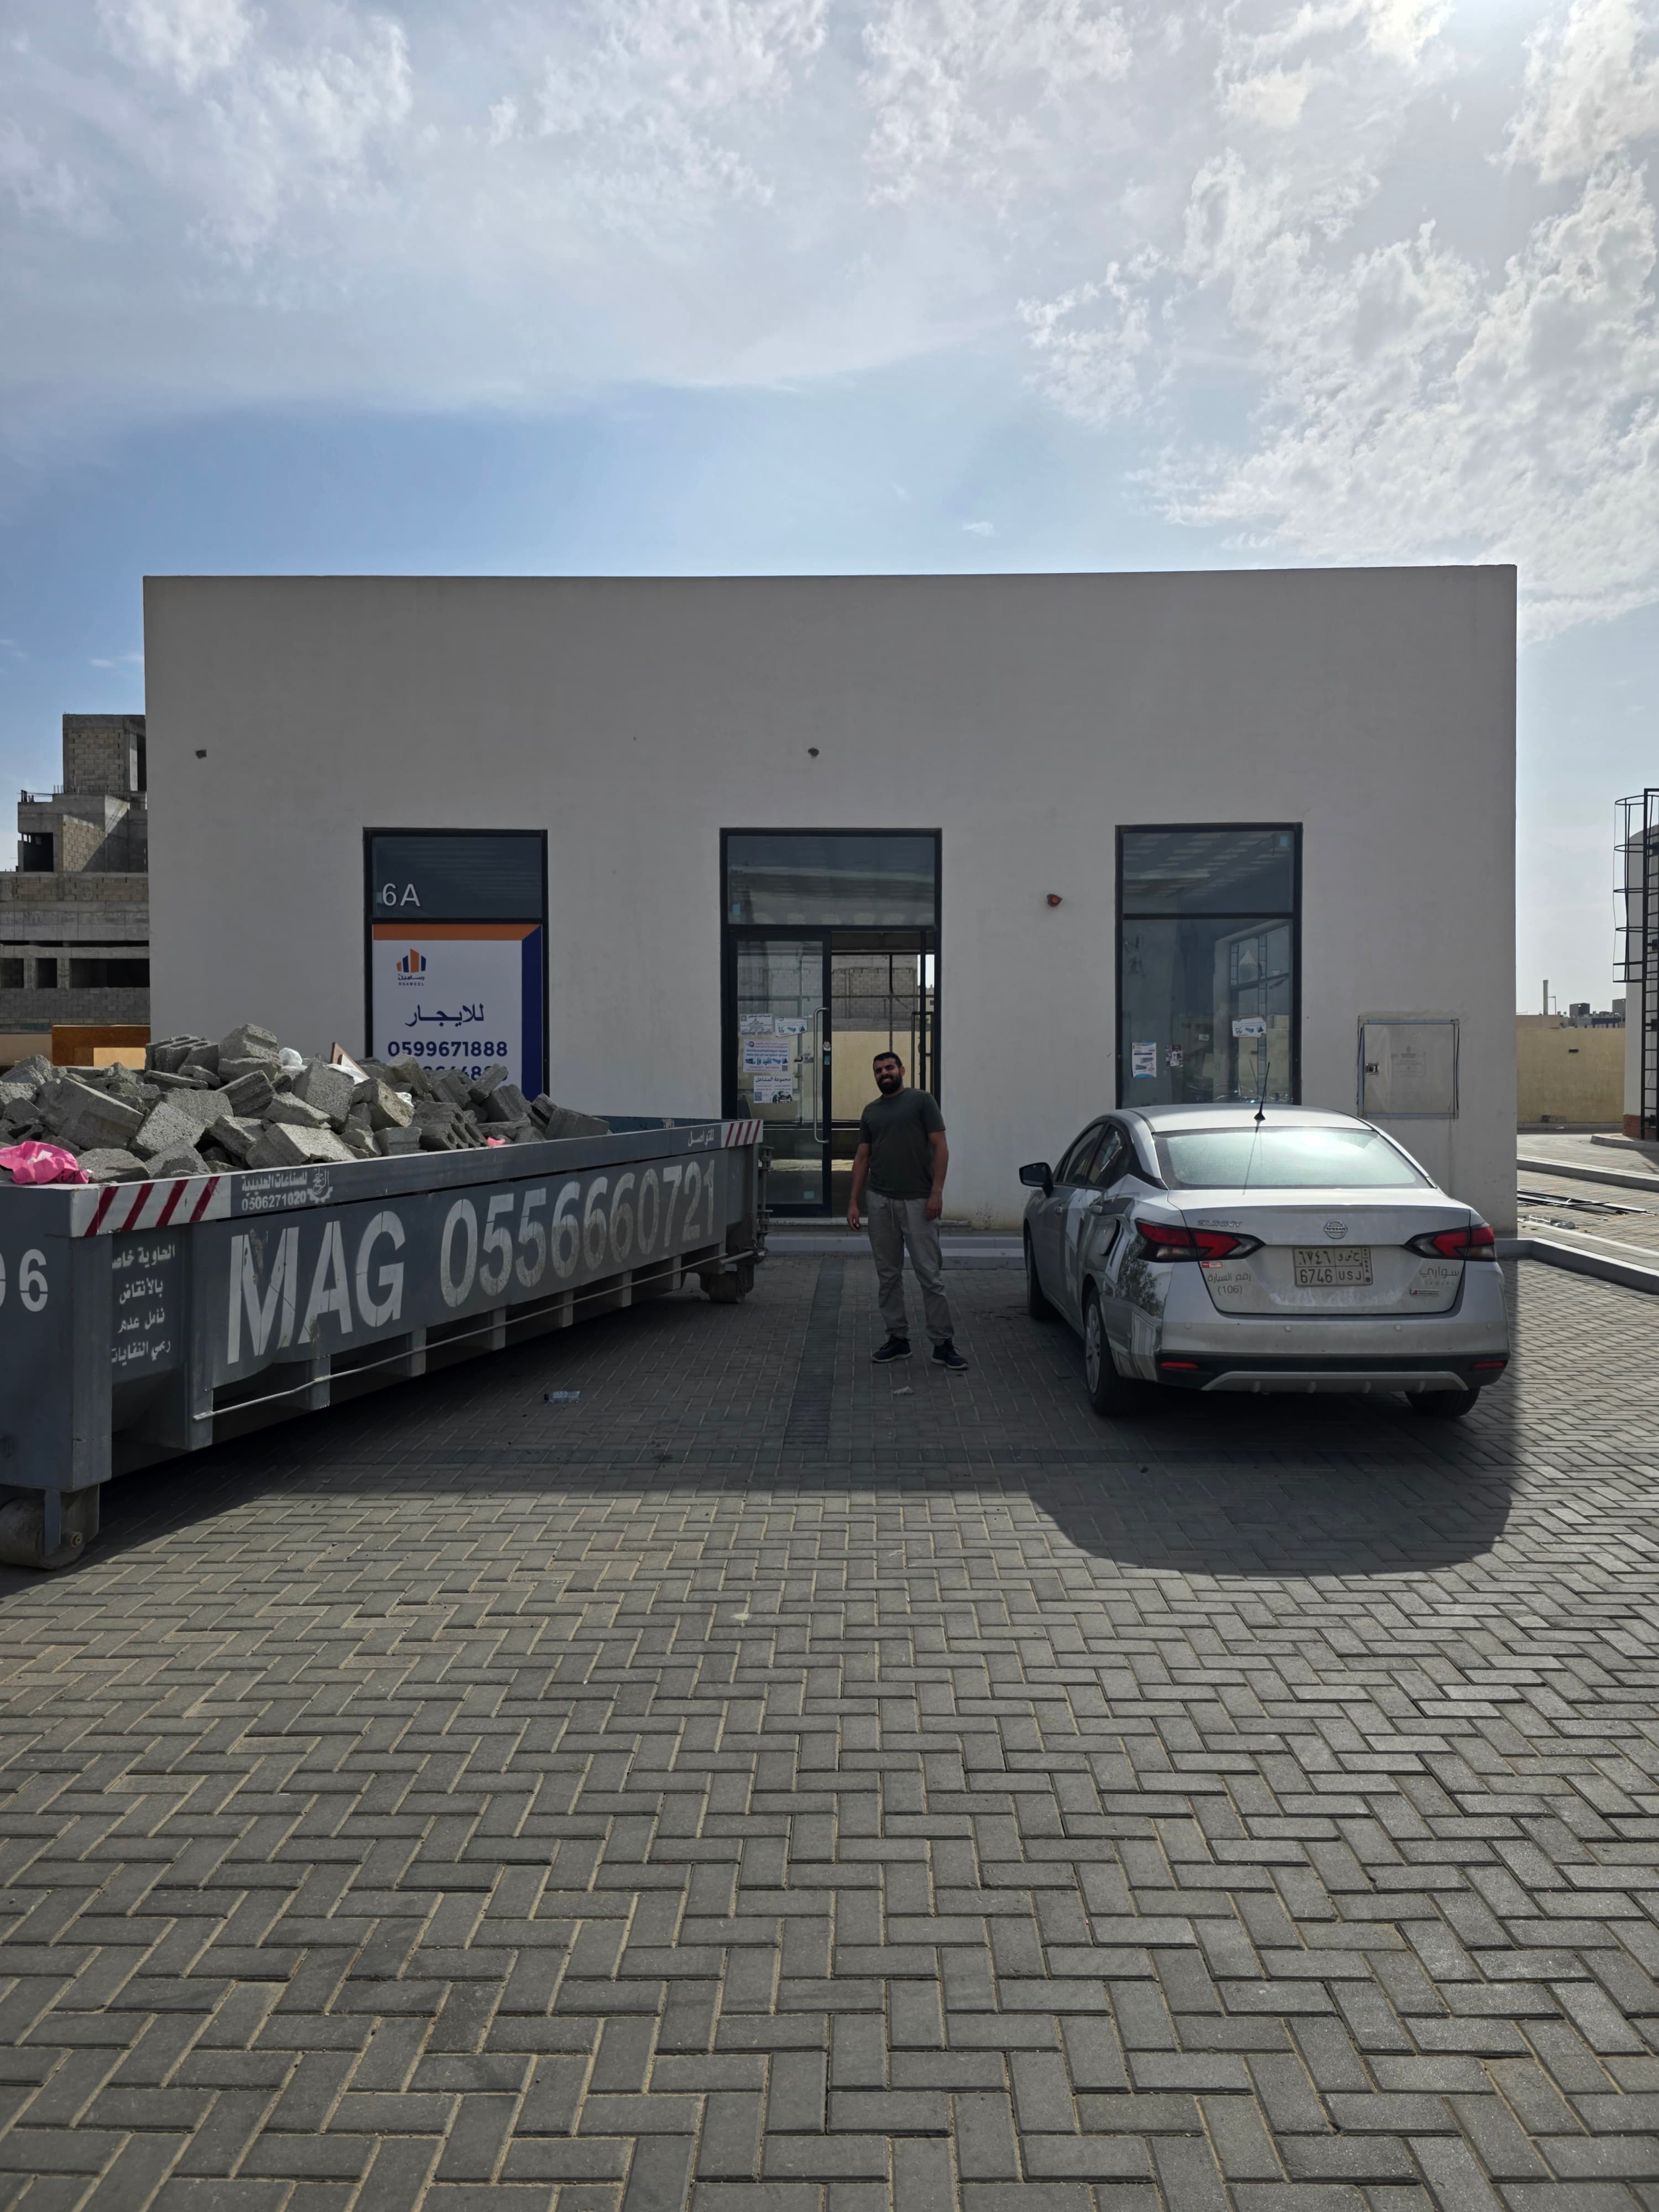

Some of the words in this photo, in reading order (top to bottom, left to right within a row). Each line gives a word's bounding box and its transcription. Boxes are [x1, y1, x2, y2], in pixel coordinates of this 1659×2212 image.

[382, 883, 421, 907] 6A
[404, 1003, 484, 1027] للايجار
[388, 1041, 508, 1057] 0599671888
[275, 1171, 307, 1188] للصناعات
[242, 1191, 307, 1211] 0506271020
[138, 1244, 175, 1268] الحاوية
[227, 1211, 406, 1365] MAG
[440, 1159, 715, 1308] 0556660721
[0, 1249, 49, 1312] 6
[1235, 1272, 1251, 1282] رقم
[1300, 1268, 1333, 1284] 6746
[1217, 1285, 1243, 1296] (106)
